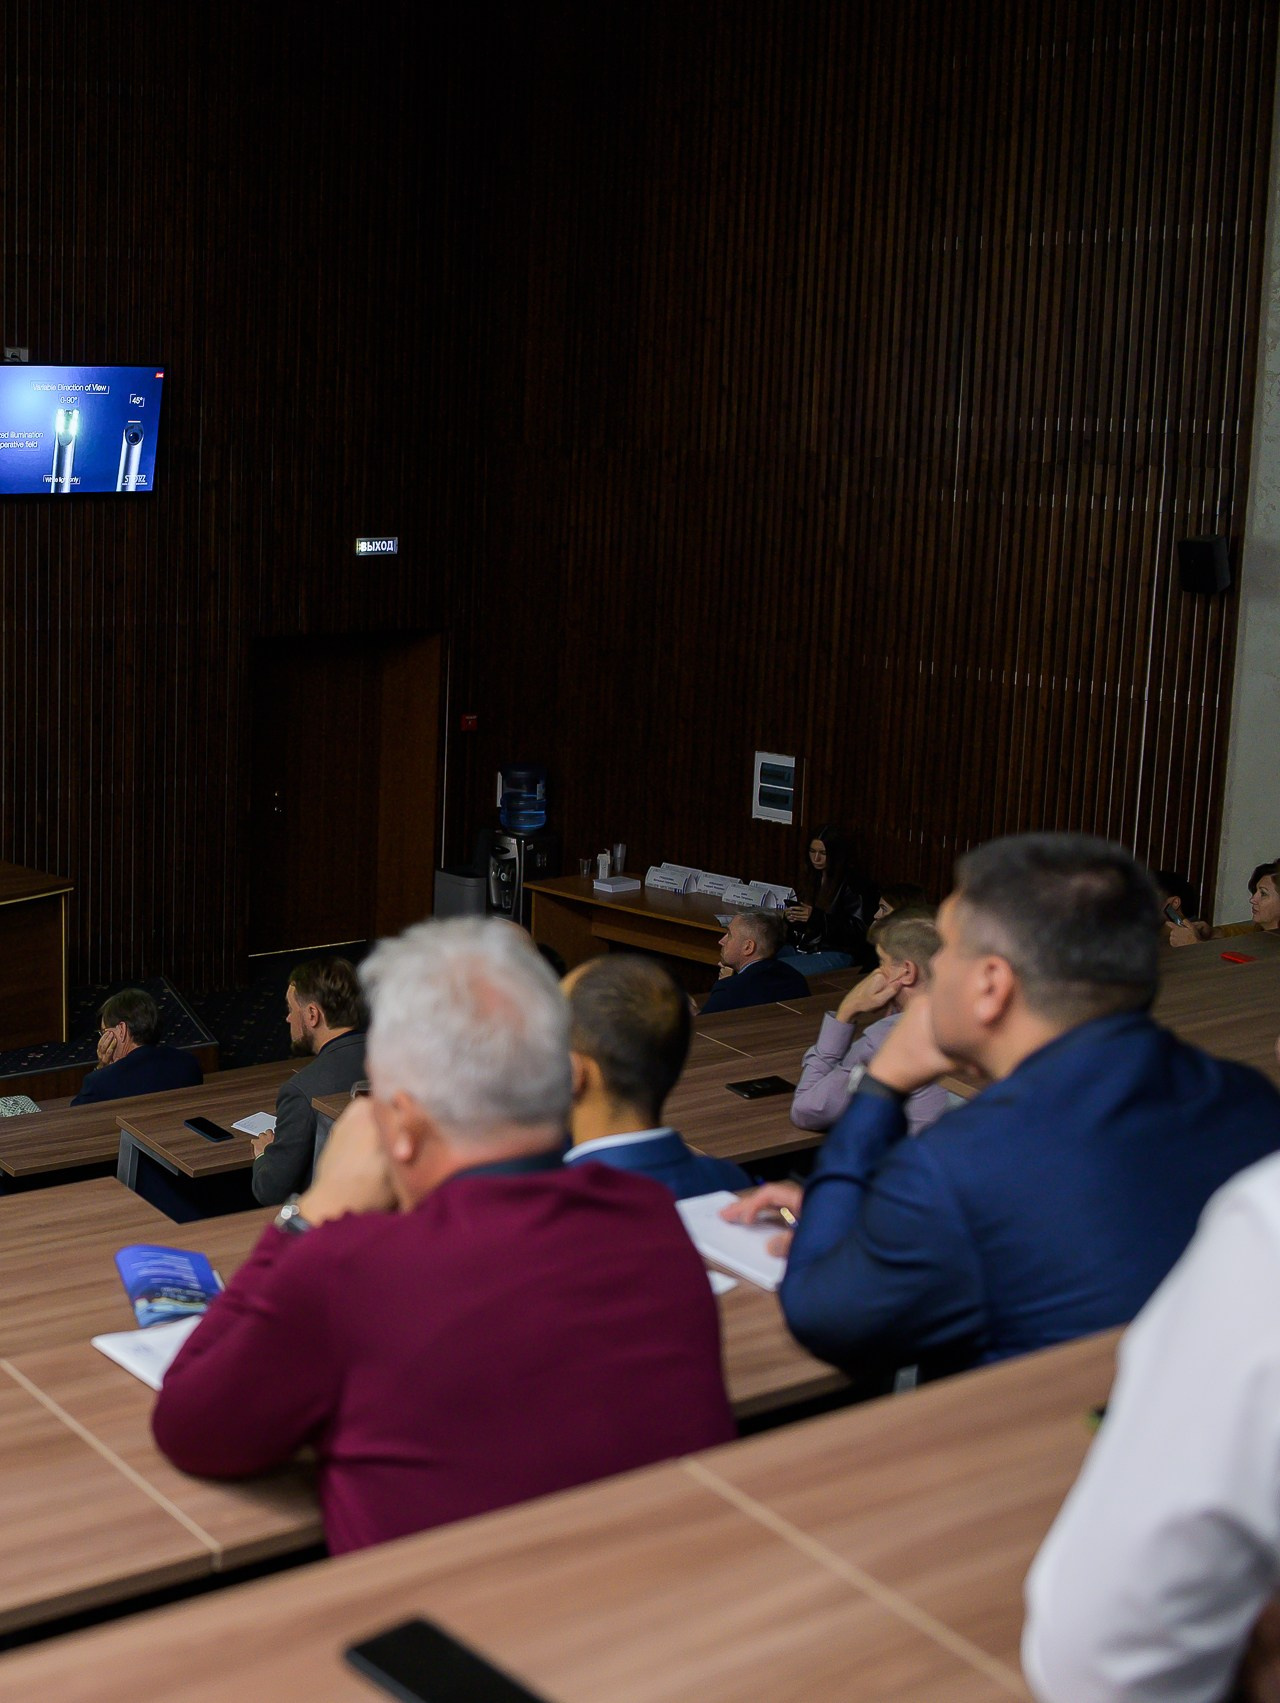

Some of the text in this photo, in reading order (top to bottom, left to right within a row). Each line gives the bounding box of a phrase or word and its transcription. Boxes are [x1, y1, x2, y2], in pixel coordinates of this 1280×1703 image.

[57, 383, 84, 392] Direction
[84, 383, 92, 392] of
[92, 383, 107, 392] View
[25, 440, 38, 449] field
[360, 540, 394, 552] ВЫХОД
